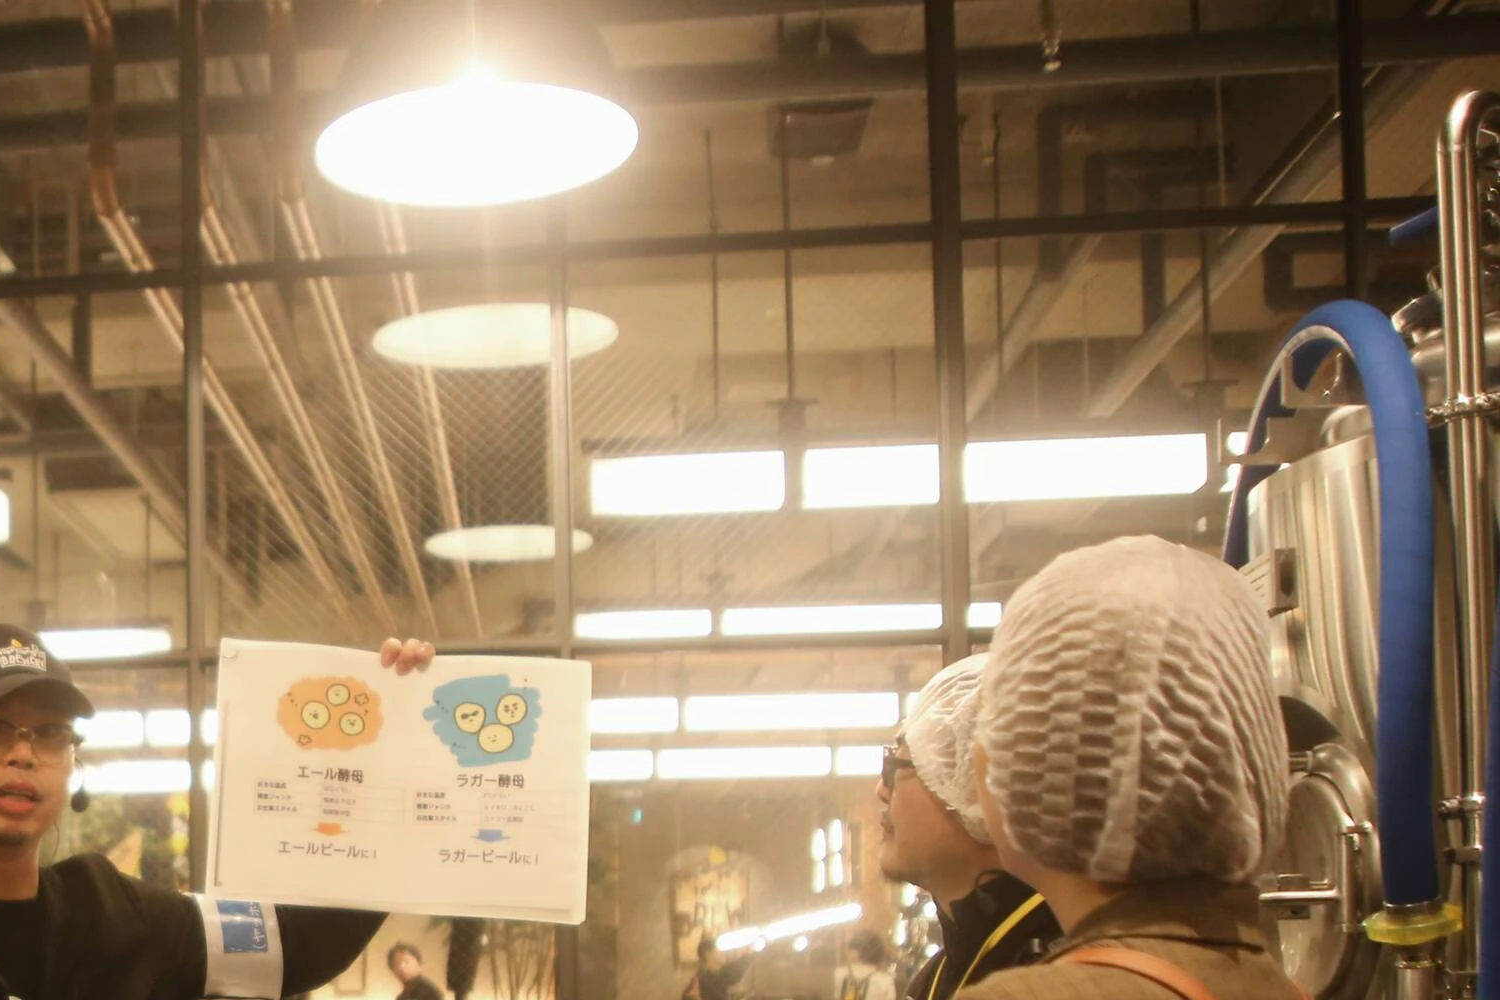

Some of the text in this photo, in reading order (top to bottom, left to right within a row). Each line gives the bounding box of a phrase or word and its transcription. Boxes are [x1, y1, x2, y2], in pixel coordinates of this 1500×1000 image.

[297, 766, 364, 783] エール酵母
[456, 774, 525, 789] ラガー酵母
